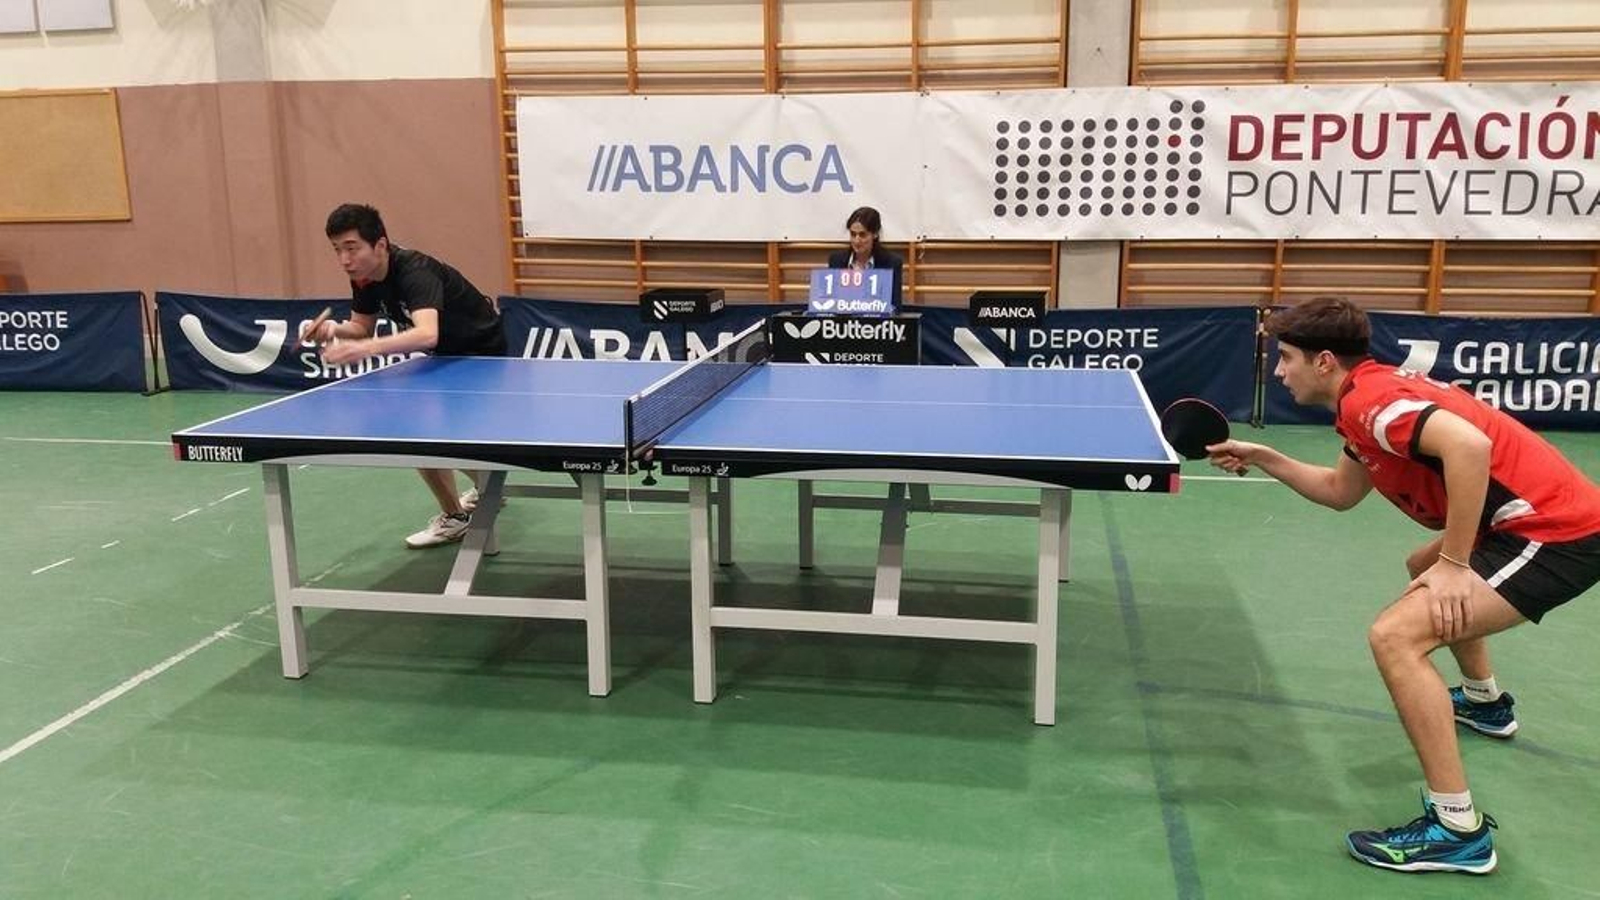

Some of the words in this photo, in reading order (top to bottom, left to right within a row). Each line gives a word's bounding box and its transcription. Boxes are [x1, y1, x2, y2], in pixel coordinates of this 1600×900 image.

[825, 274, 834, 295] 1
[869, 274, 878, 295] 1
[837, 300, 887, 313] Butterfly
[822, 320, 905, 342] Butterfly
[1028, 328, 1159, 348] DEPORTE
[0, 333, 60, 351] LEGO
[834, 352, 884, 362] DEPORTE
[1451, 379, 1600, 411] AUDA
[188, 445, 243, 461] BUTTERFLY
[563, 461, 591, 471] Europa
[592, 462, 602, 471] 25
[672, 464, 700, 474] Europa
[701, 465, 712, 474] 25
